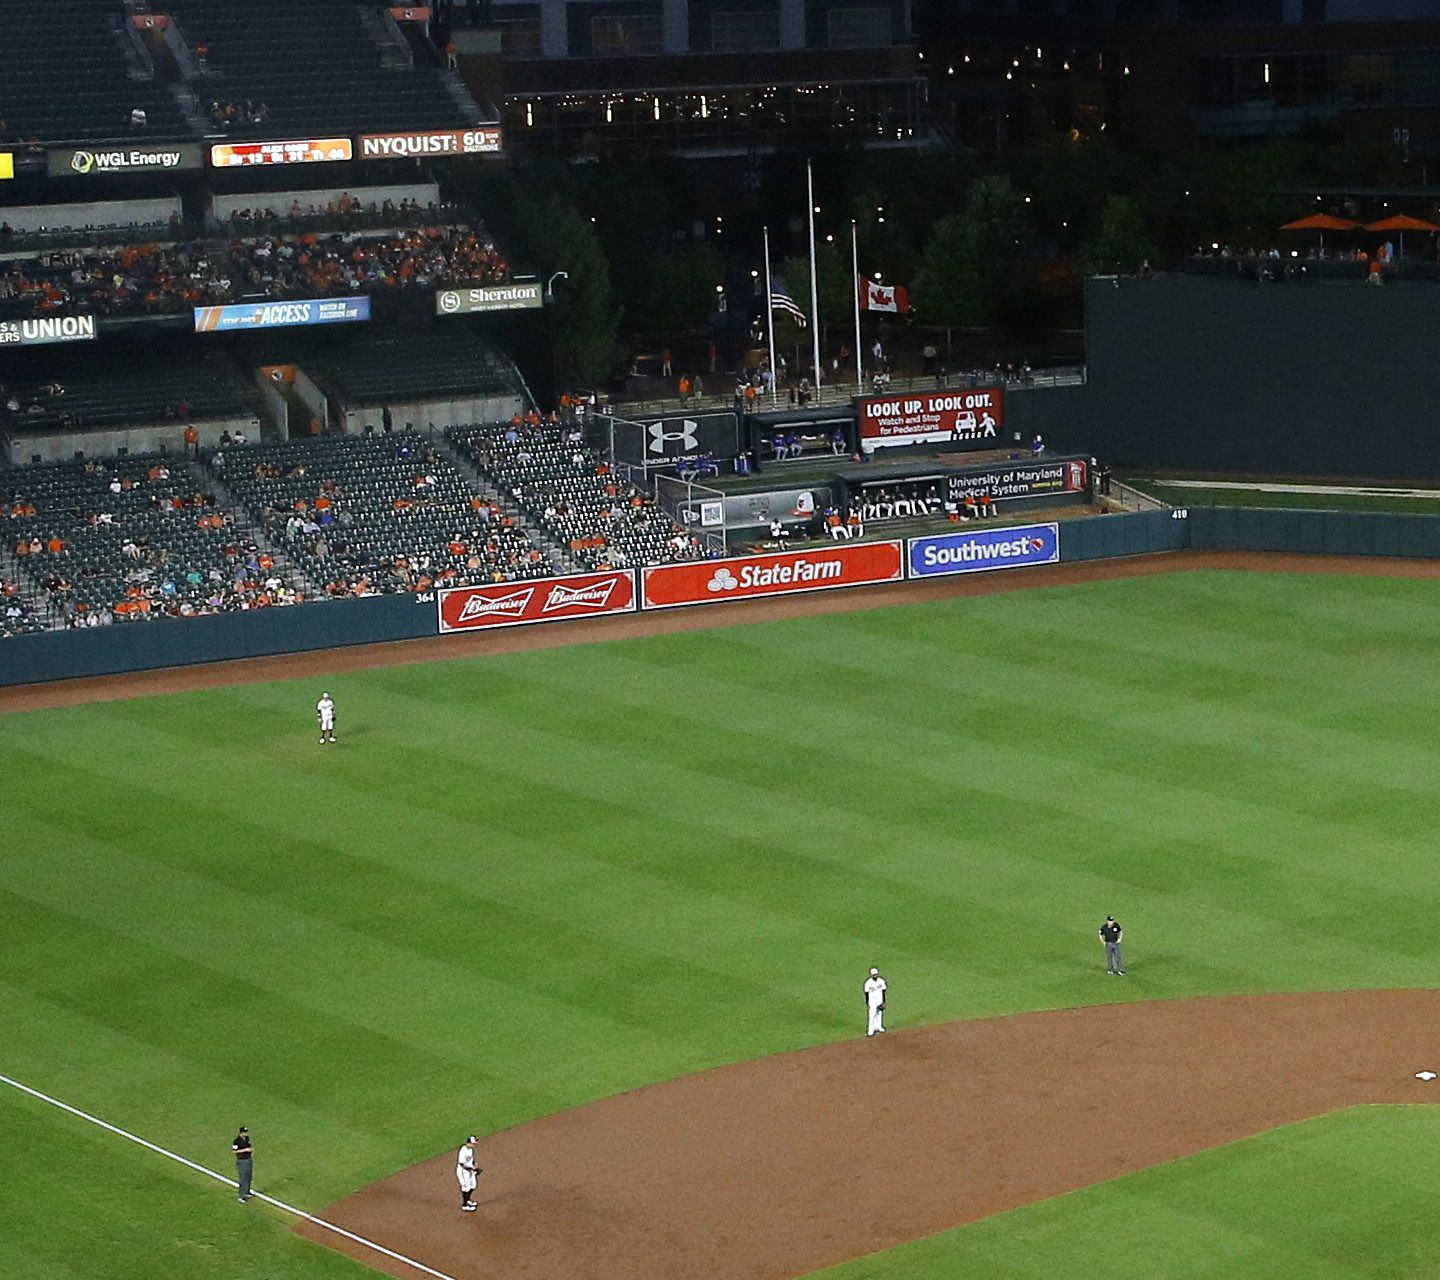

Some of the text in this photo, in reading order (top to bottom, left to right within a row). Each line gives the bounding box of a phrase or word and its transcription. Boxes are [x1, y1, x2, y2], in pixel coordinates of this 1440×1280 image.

[364, 135, 452, 157] NYQUIST
[463, 131, 485, 145] 60
[469, 286, 536, 302] Sheraton
[261, 304, 311, 324] ACCESS
[9, 322, 18, 332] &
[22, 316, 93, 340] UNION
[866, 394, 993, 417] LOOK UP. LOOK OUT.
[878, 413, 941, 426] Watch and Stop
[880, 423, 939, 435] for Pedestrians
[949, 468, 1063, 488] University of Maryland
[949, 485, 990, 499] Medical
[991, 483, 1029, 496] System
[1171, 509, 1187, 519] 410
[924, 536, 1030, 566] Southwest
[550, 587, 609, 605] Budweiser
[468, 596, 526, 615] Budweiser
